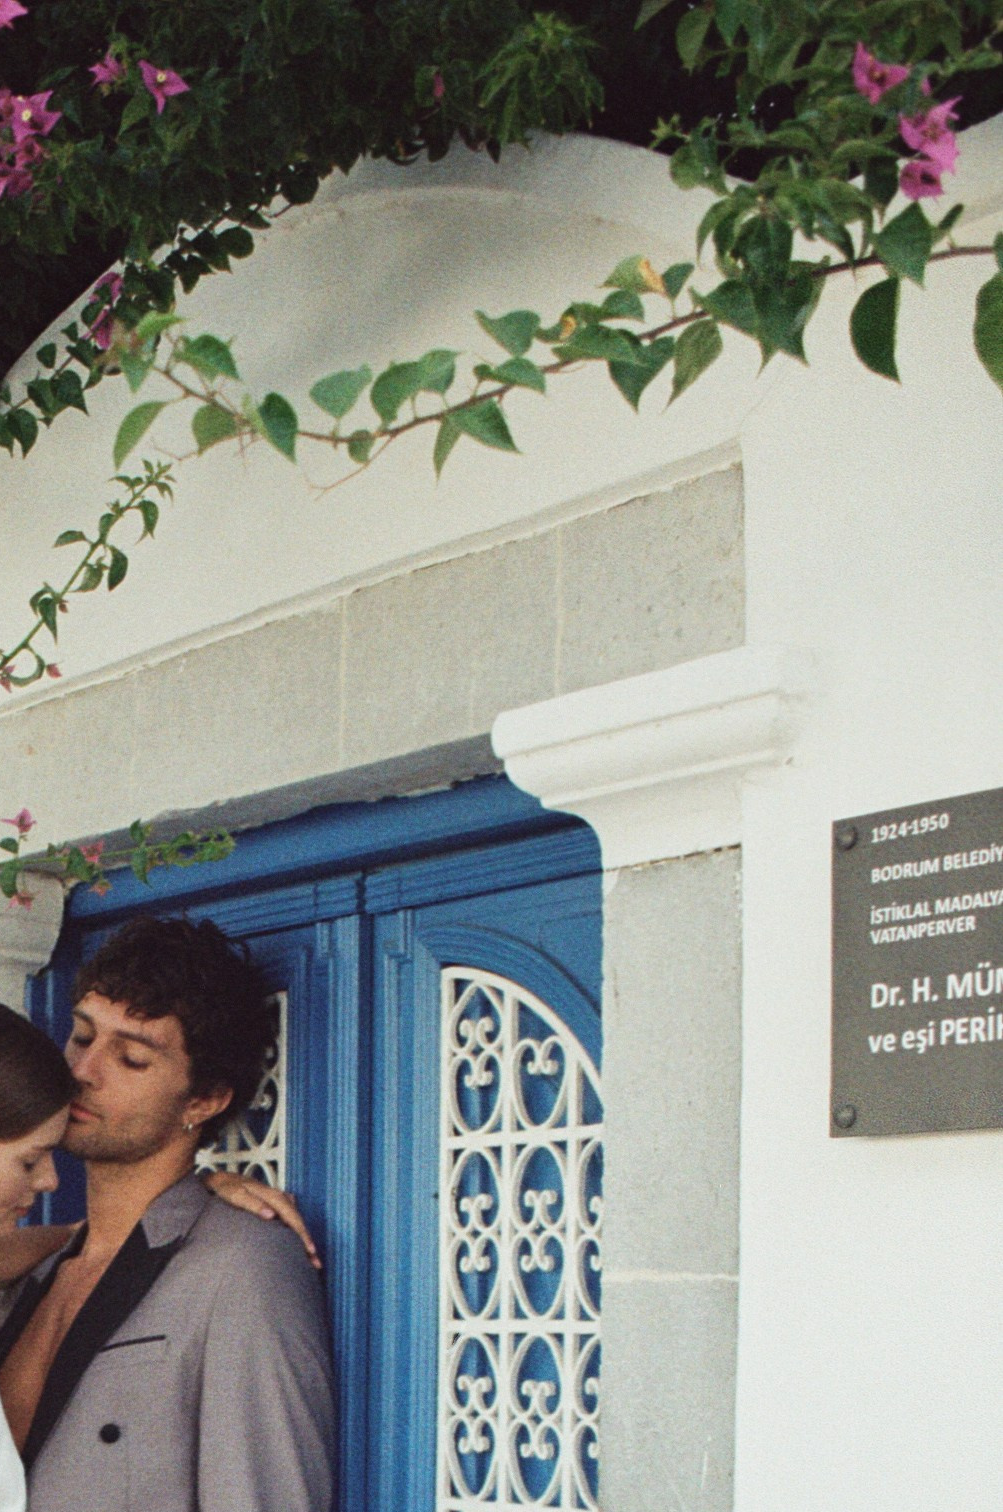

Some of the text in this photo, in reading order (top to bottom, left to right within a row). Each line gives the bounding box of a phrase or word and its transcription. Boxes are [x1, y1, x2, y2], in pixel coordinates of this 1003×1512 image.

[871, 812, 950, 843] 1924-1950
[871, 857, 940, 884] BODRUM
[870, 901, 932, 925] İSTİKLAL
[870, 915, 976, 945] VATANPERVER
[871, 982, 905, 1009] Dr.
[912, 976, 939, 1004] H.
[868, 1033, 896, 1053] ve
[901, 1021, 935, 1054] eşi
